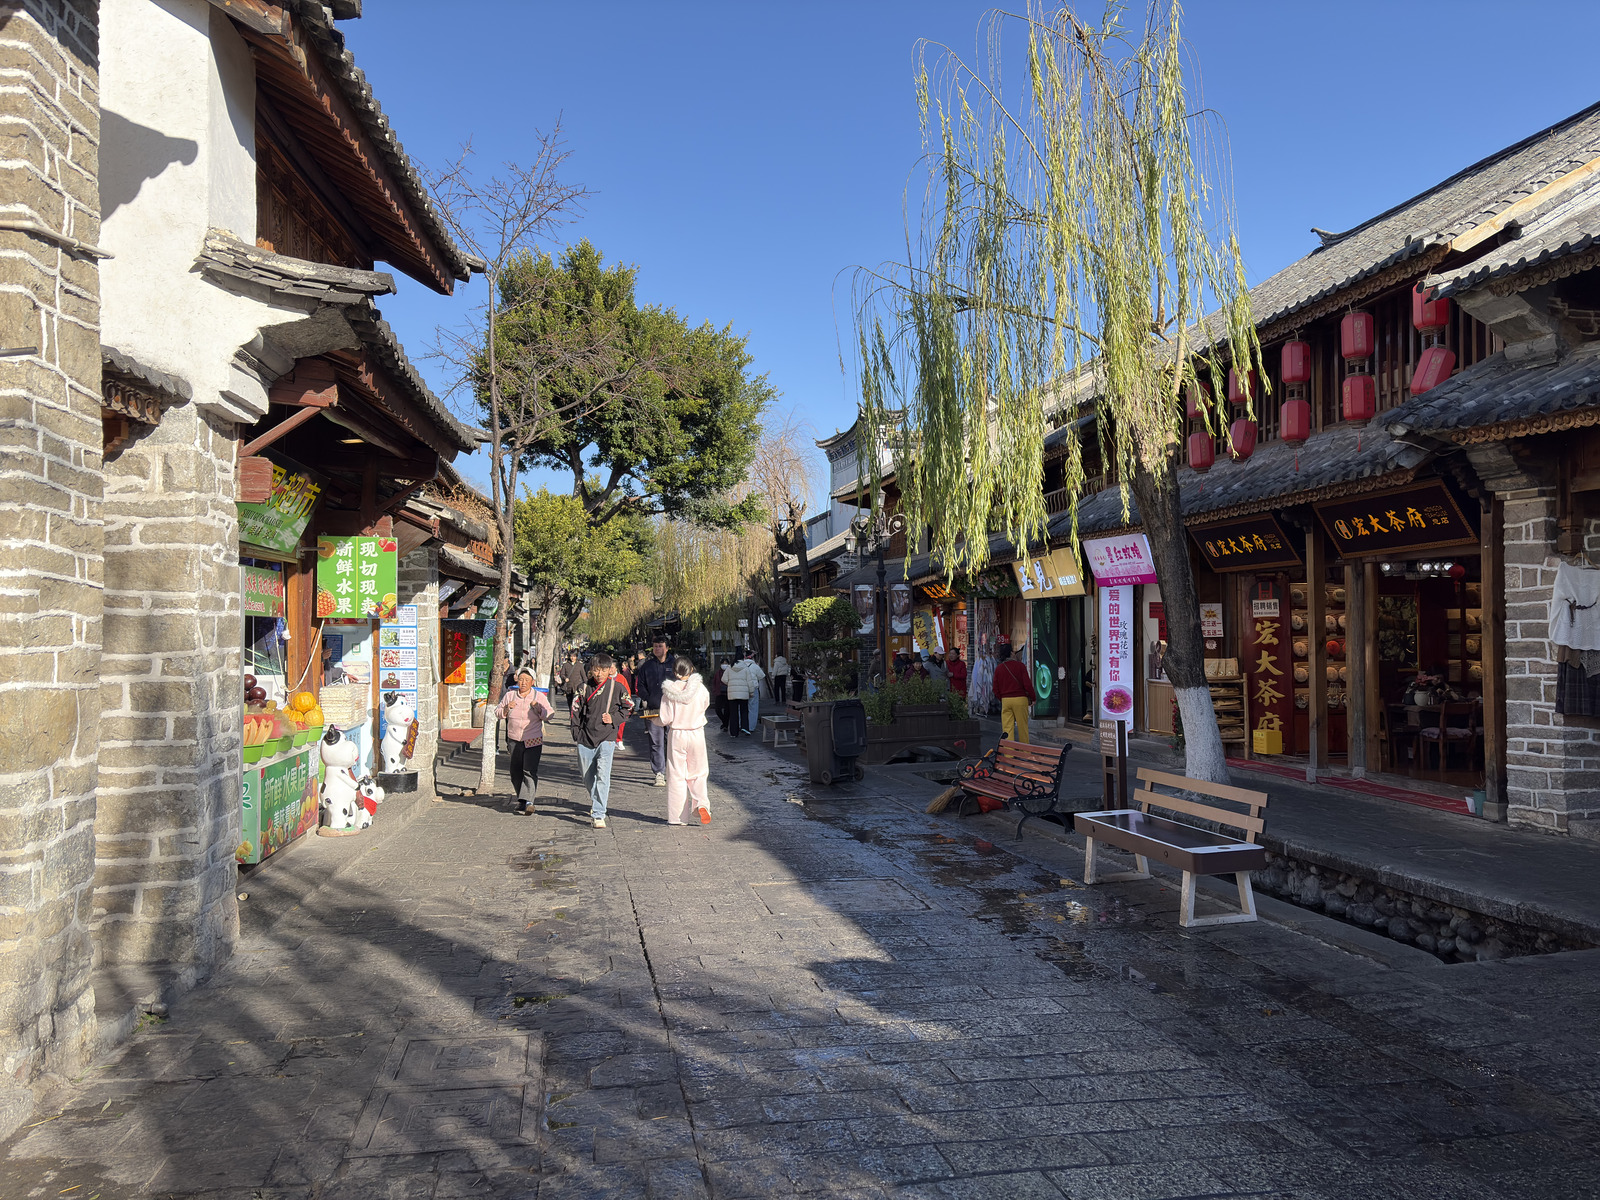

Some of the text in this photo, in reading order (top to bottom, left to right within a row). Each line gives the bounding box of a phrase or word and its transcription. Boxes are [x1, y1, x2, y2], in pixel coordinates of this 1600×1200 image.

[1216, 533, 1267, 555] 宏大茶府
[1352, 507, 1426, 536] 宏大茶府
[1105, 541, 1142, 563] 墨红玫瑰
[336, 540, 354, 614] 新鲜水果
[360, 541, 378, 615] 现切现卖
[1253, 601, 1278, 610] 招聘销售
[1108, 585, 1120, 682] 爱的世界只有你
[1252, 620, 1285, 731] 宏大茶府
[264, 762, 306, 811] 新鲜水果店
